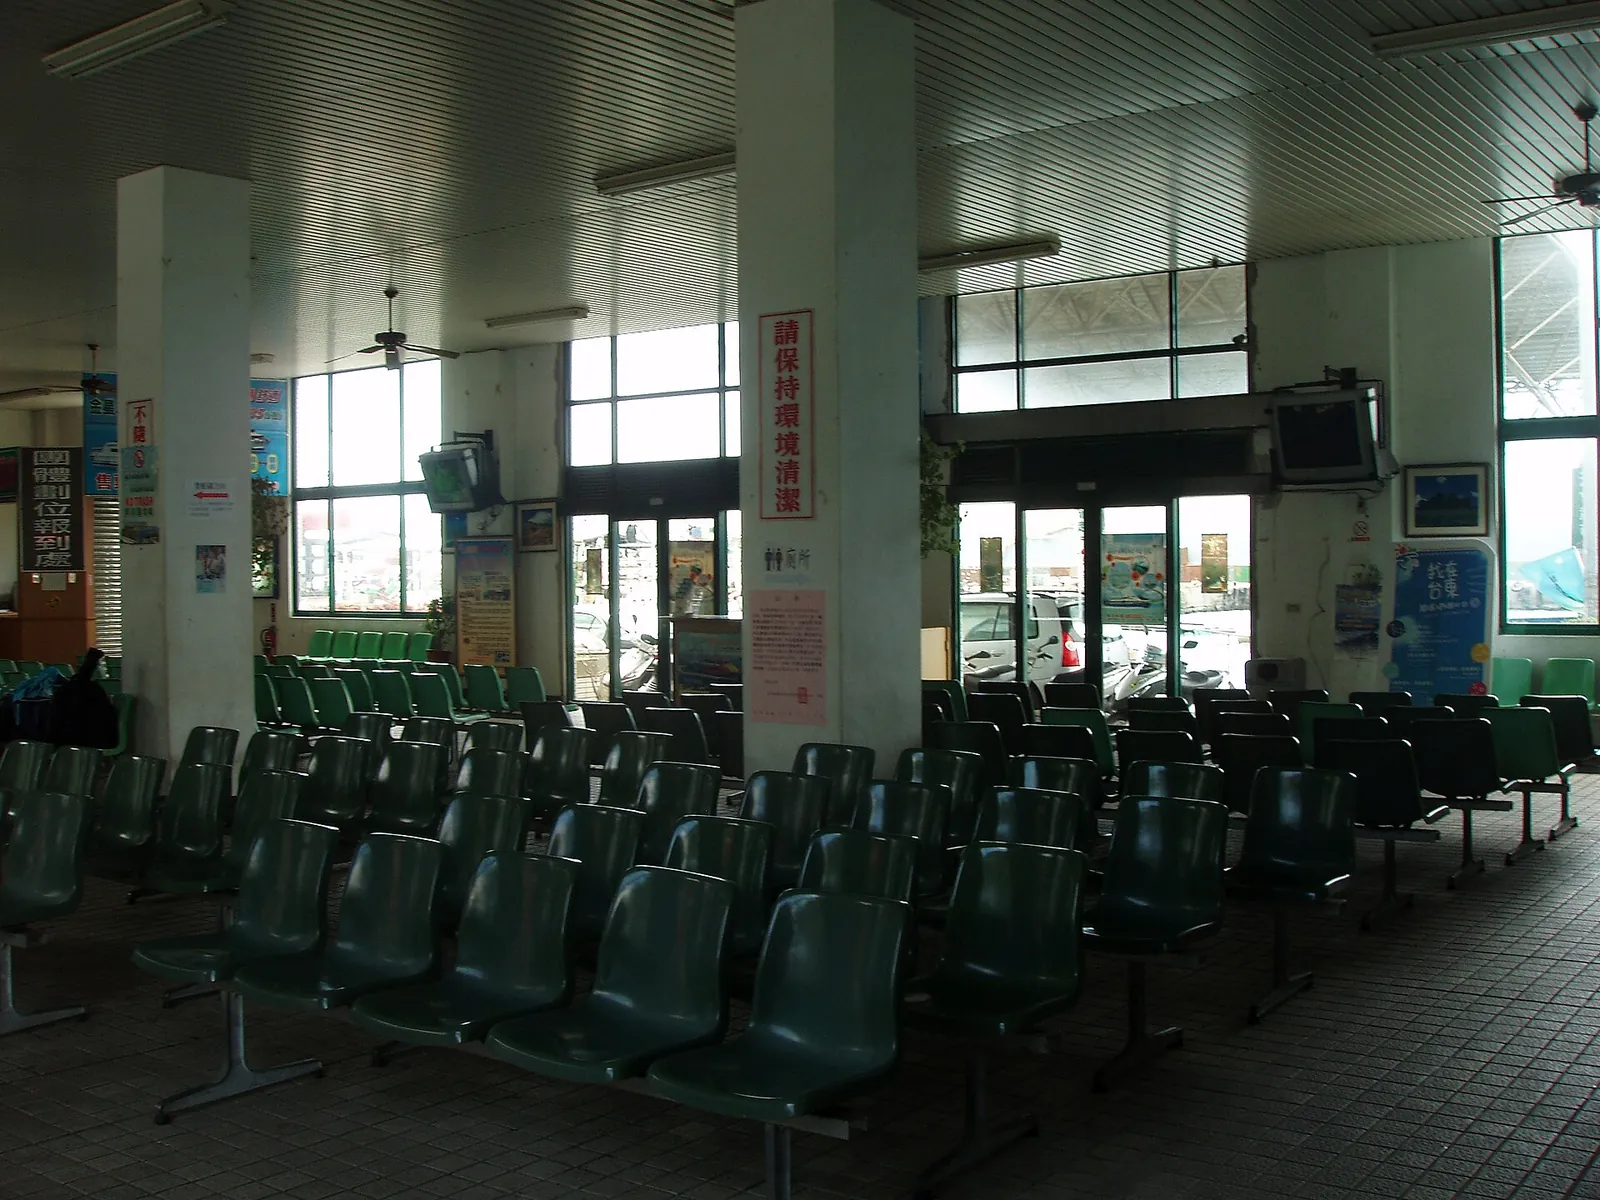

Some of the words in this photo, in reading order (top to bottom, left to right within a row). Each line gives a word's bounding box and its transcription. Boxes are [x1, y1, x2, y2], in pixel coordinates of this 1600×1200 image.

[773, 319, 801, 513] 請保持環境清潔
[33, 450, 72, 567] 團體劃位報到處
